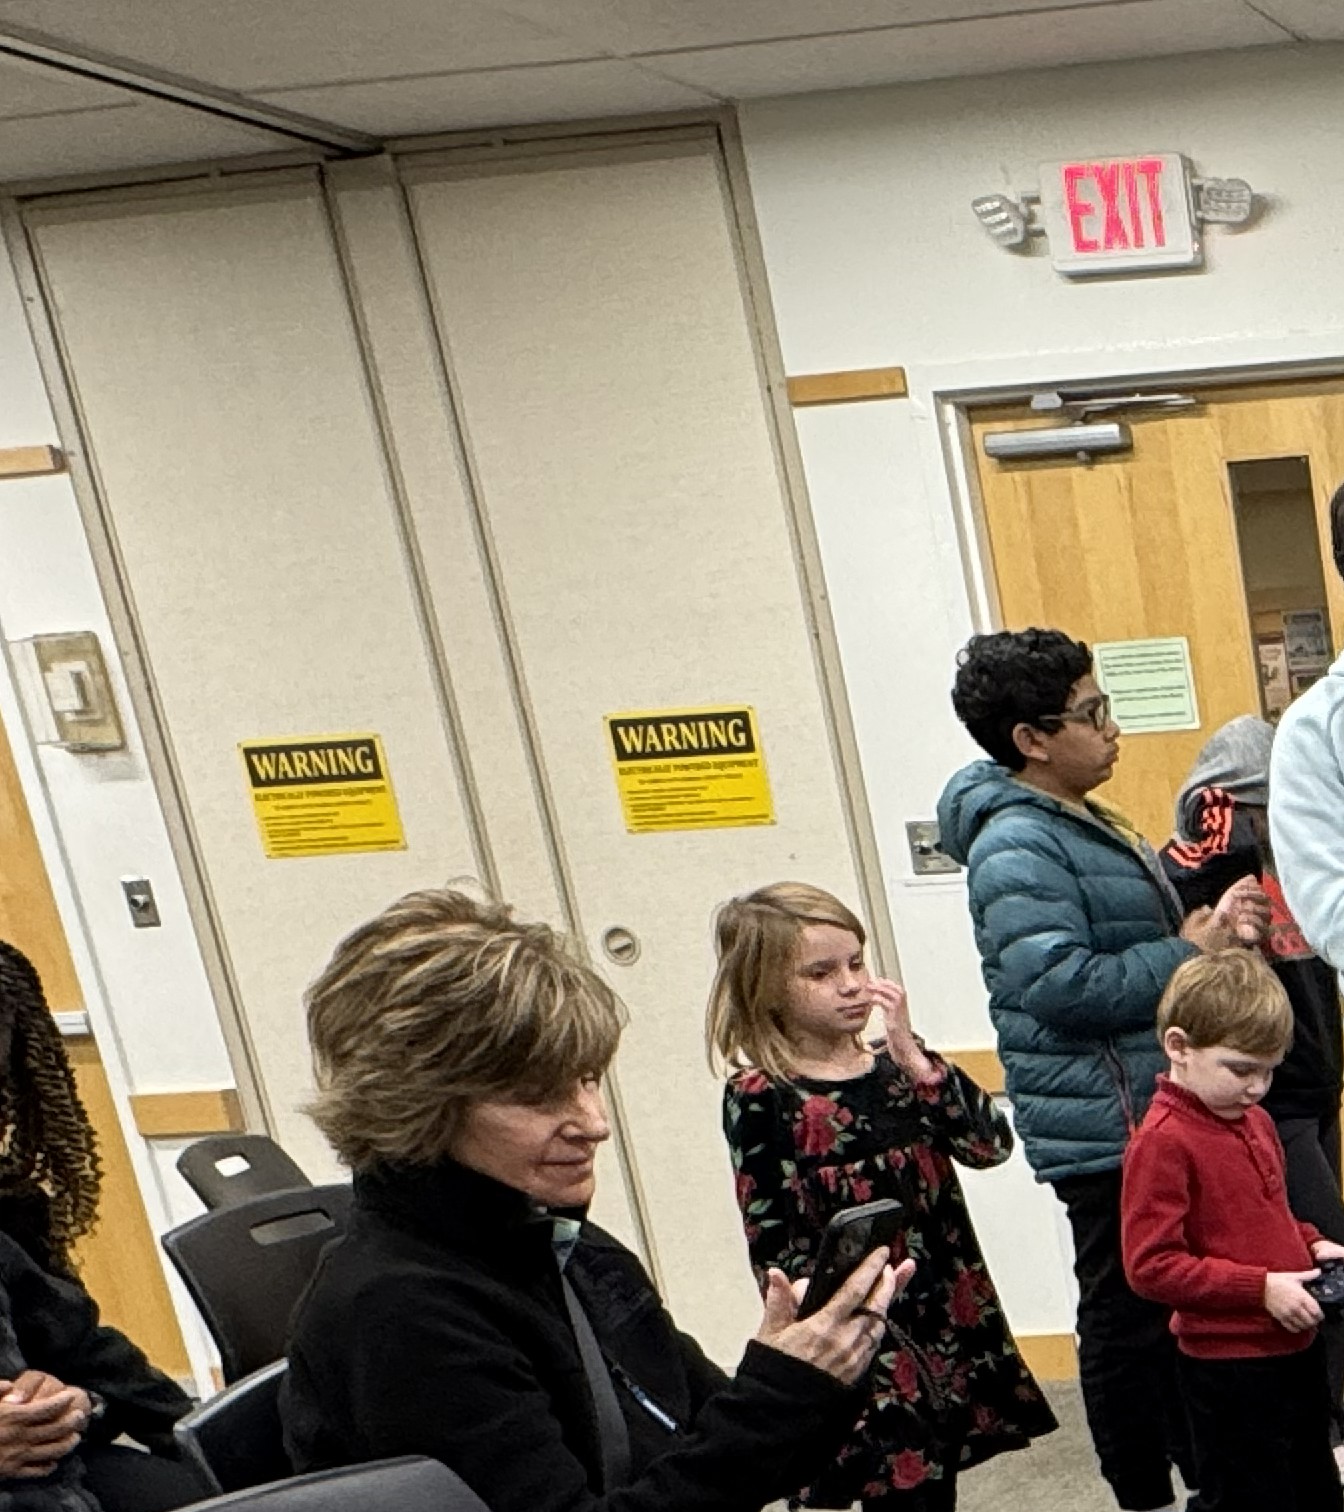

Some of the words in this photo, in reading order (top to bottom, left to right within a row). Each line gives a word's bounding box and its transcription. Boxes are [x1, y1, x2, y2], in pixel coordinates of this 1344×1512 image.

[1063, 159, 1166, 253] EXIT
[617, 718, 747, 754] WARNING
[250, 746, 374, 781] WARNING
